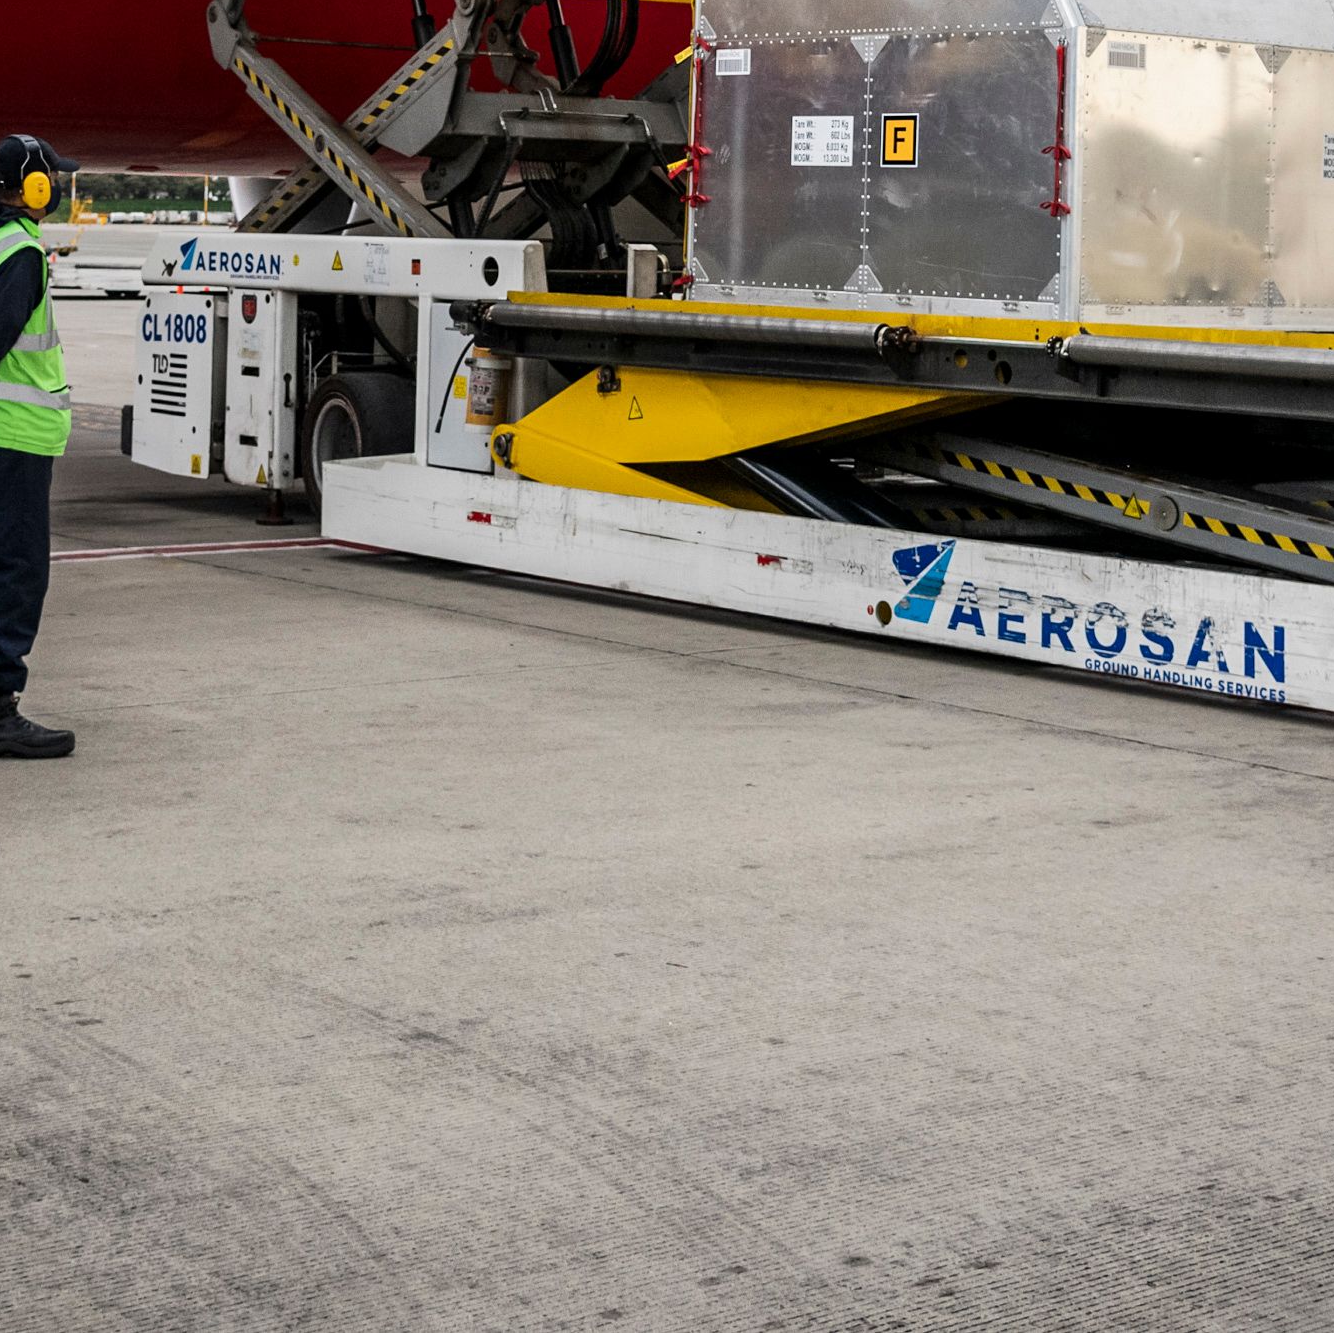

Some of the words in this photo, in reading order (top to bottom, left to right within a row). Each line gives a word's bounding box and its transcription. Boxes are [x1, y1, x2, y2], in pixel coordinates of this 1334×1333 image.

[893, 127, 906, 154] F
[195, 251, 281, 274] AEROSAN
[947, 580, 1286, 684] AEROSAN
[1085, 658, 1138, 677] GROUND
[1143, 667, 1213, 689] HANDLING
[1218, 680, 1286, 703] SERVICES
